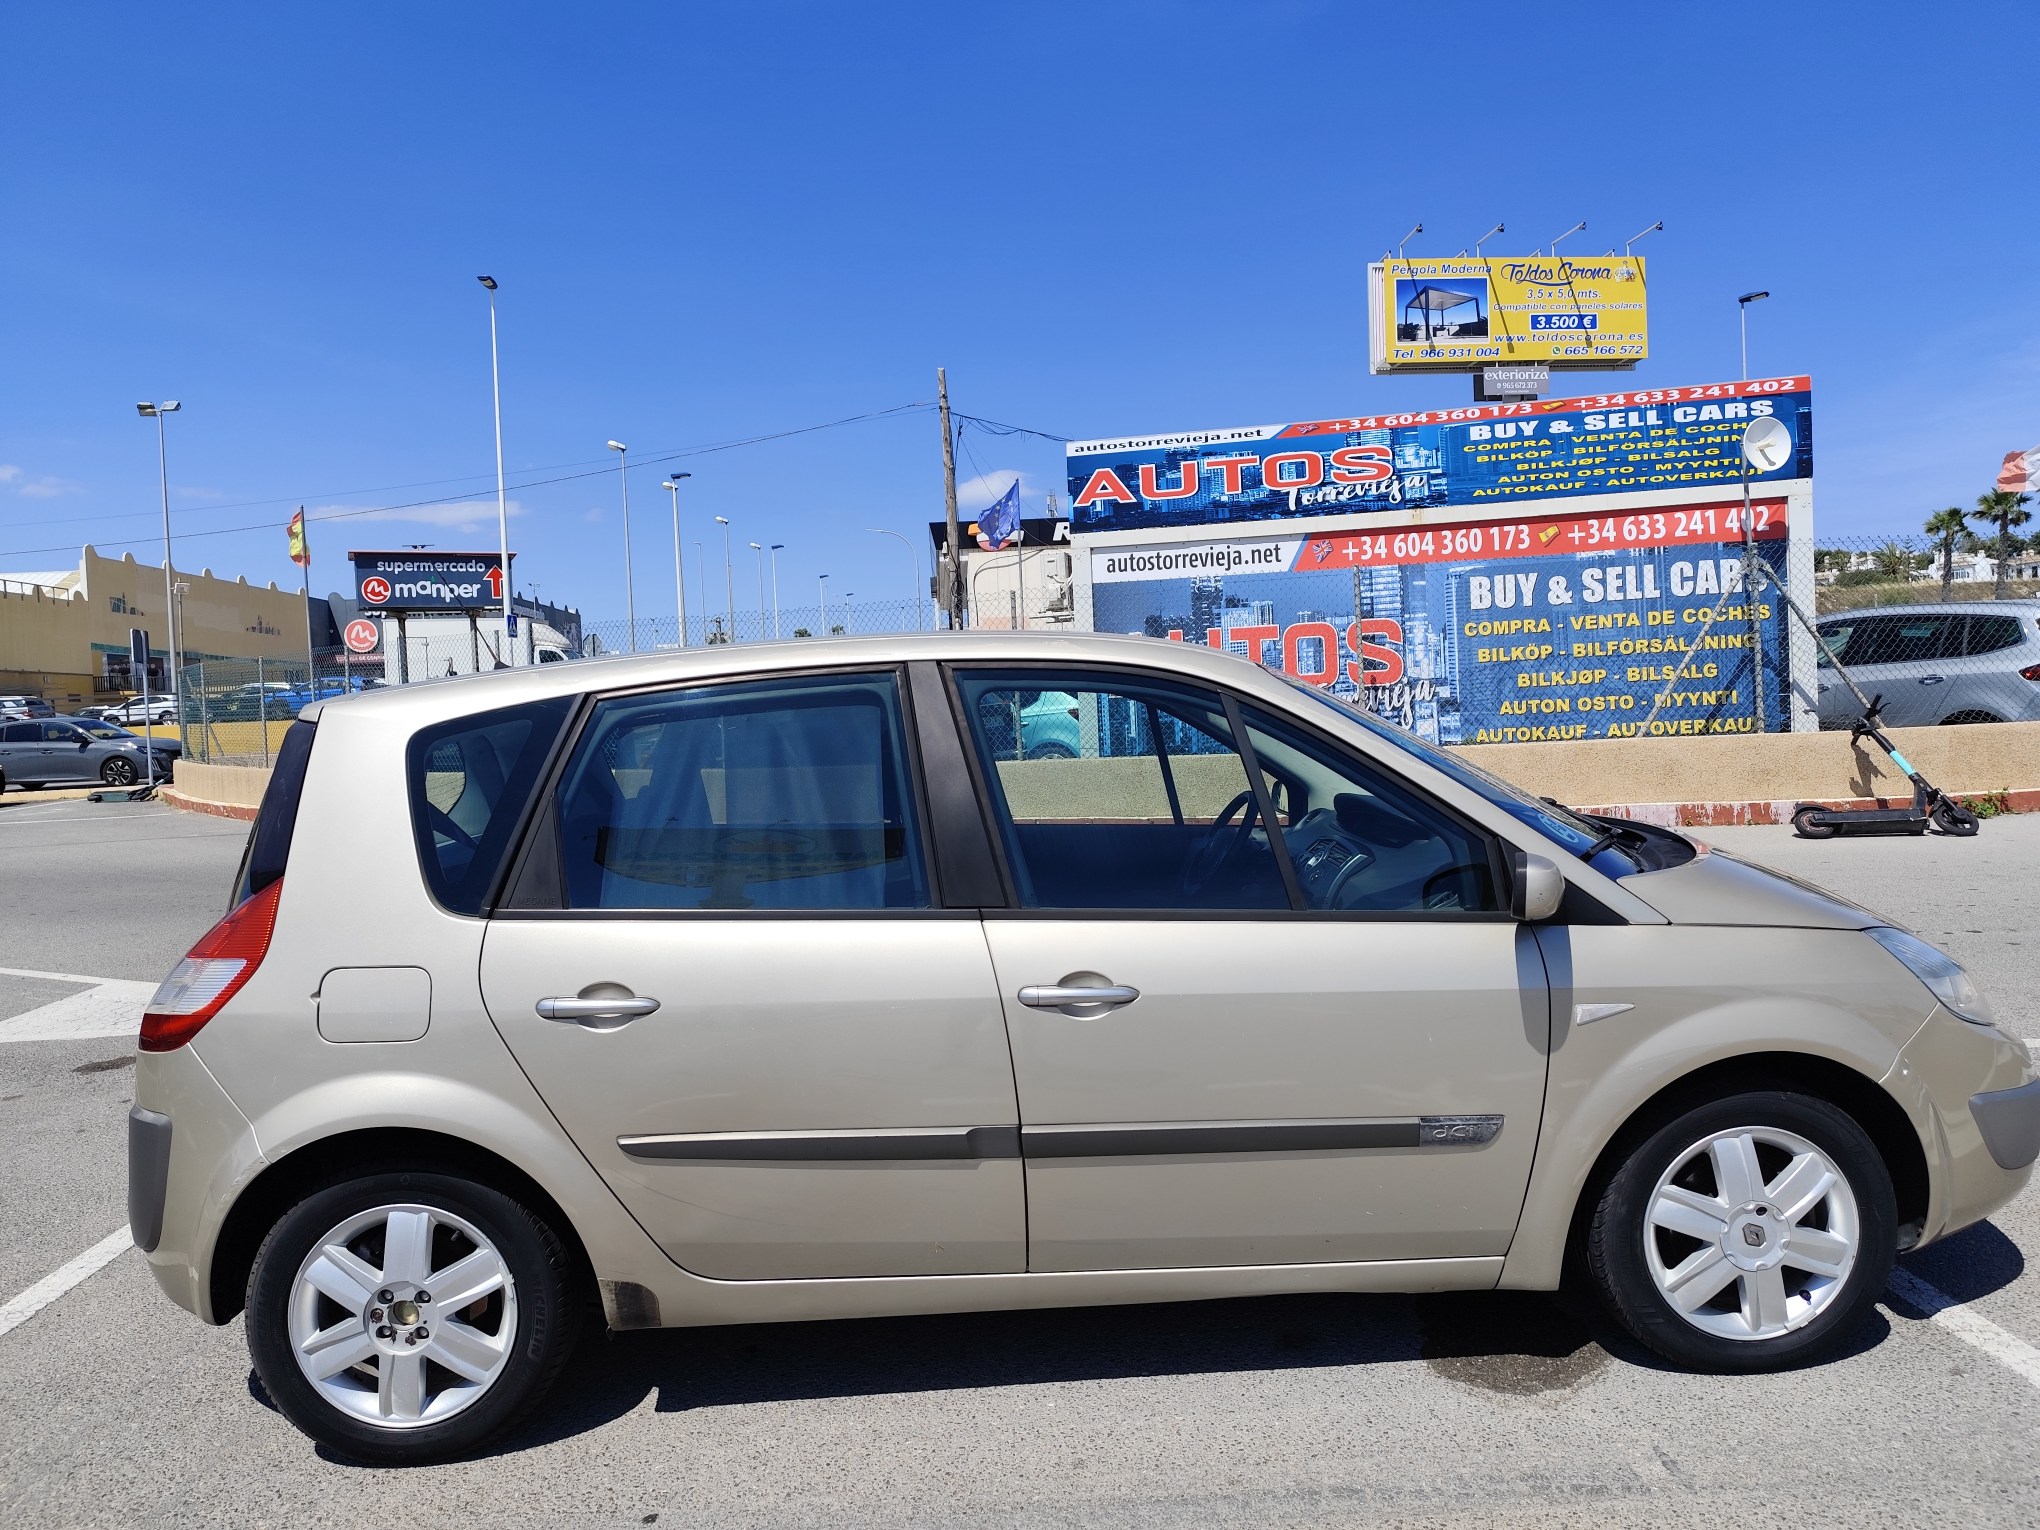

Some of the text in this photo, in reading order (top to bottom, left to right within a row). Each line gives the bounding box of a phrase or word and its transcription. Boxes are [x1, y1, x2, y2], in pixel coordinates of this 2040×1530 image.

[1391, 263, 1492, 276] Pérgola Moderna
[1500, 261, 1612, 285] Toldos Corona
[1527, 288, 1601, 300] 3,5 x 5,0 mts.
[1494, 302, 1547, 311] Compatible
[1570, 302, 1606, 311] paneles
[1609, 301, 1643, 310] solares
[1536, 315, 1593, 329] 3.500 €
[1494, 332, 1644, 343] www.toldoscorona.es
[1393, 347, 1500, 359] Tel. 966 931 004
[1564, 345, 1643, 355] 665 166 572
[1484, 368, 1549, 380] exterioriza
[1502, 381, 1538, 389] 965 672 373
[1573, 379, 1795, 408] +34 633 241 402
[1329, 403, 1533, 431] +34 604 360 173
[1469, 400, 1774, 442] BUY & SELL CARS
[1074, 428, 1264, 453] autostorrevieja.net
[1463, 437, 1551, 453] COMPRA
[1571, 430, 1643, 444] VENTA
[1650, 428, 1678, 437] DE
[1692, 422, 1747, 434] COCH
[1476, 450, 1553, 463] BILKÖP
[1573, 433, 1742, 455] BILFÖRSÄLJNIN
[1498, 470, 1578, 484] AUTON
[1586, 465, 1635, 478] OSTO
[1655, 457, 1741, 472] MYYNTI
[1516, 457, 1607, 471] BILKJØP
[1627, 448, 1720, 462] BILSALG
[1073, 446, 1394, 507] AUTOS
[1283, 473, 1425, 511] Torrevieja
[1472, 480, 1586, 497] AUTOKAUF
[1568, 518, 1617, 545] +34
[1623, 514, 1667, 540] 633
[1674, 509, 1716, 535] 241
[1342, 524, 1531, 561] +34 604 360 173
[376, 559, 486, 575] supermercado
[1106, 542, 1282, 574] autostorrevieja.net
[394, 580, 481, 603] manper
[1469, 571, 1538, 611] BUY
[1547, 574, 1573, 606] &
[1581, 563, 1661, 604] SELL
[1464, 617, 1551, 637] COMPRA
[1570, 612, 1641, 631] VENTA
[1647, 609, 1676, 626] DE
[1477, 642, 1554, 663] BILKÖP
[1517, 668, 1607, 688] BILKJØP
[1627, 662, 1718, 682] BILSALG
[1499, 699, 1576, 716] AUTON
[1578, 695, 1635, 712] OSTO
[1476, 724, 1587, 743] AUTOKAUF
